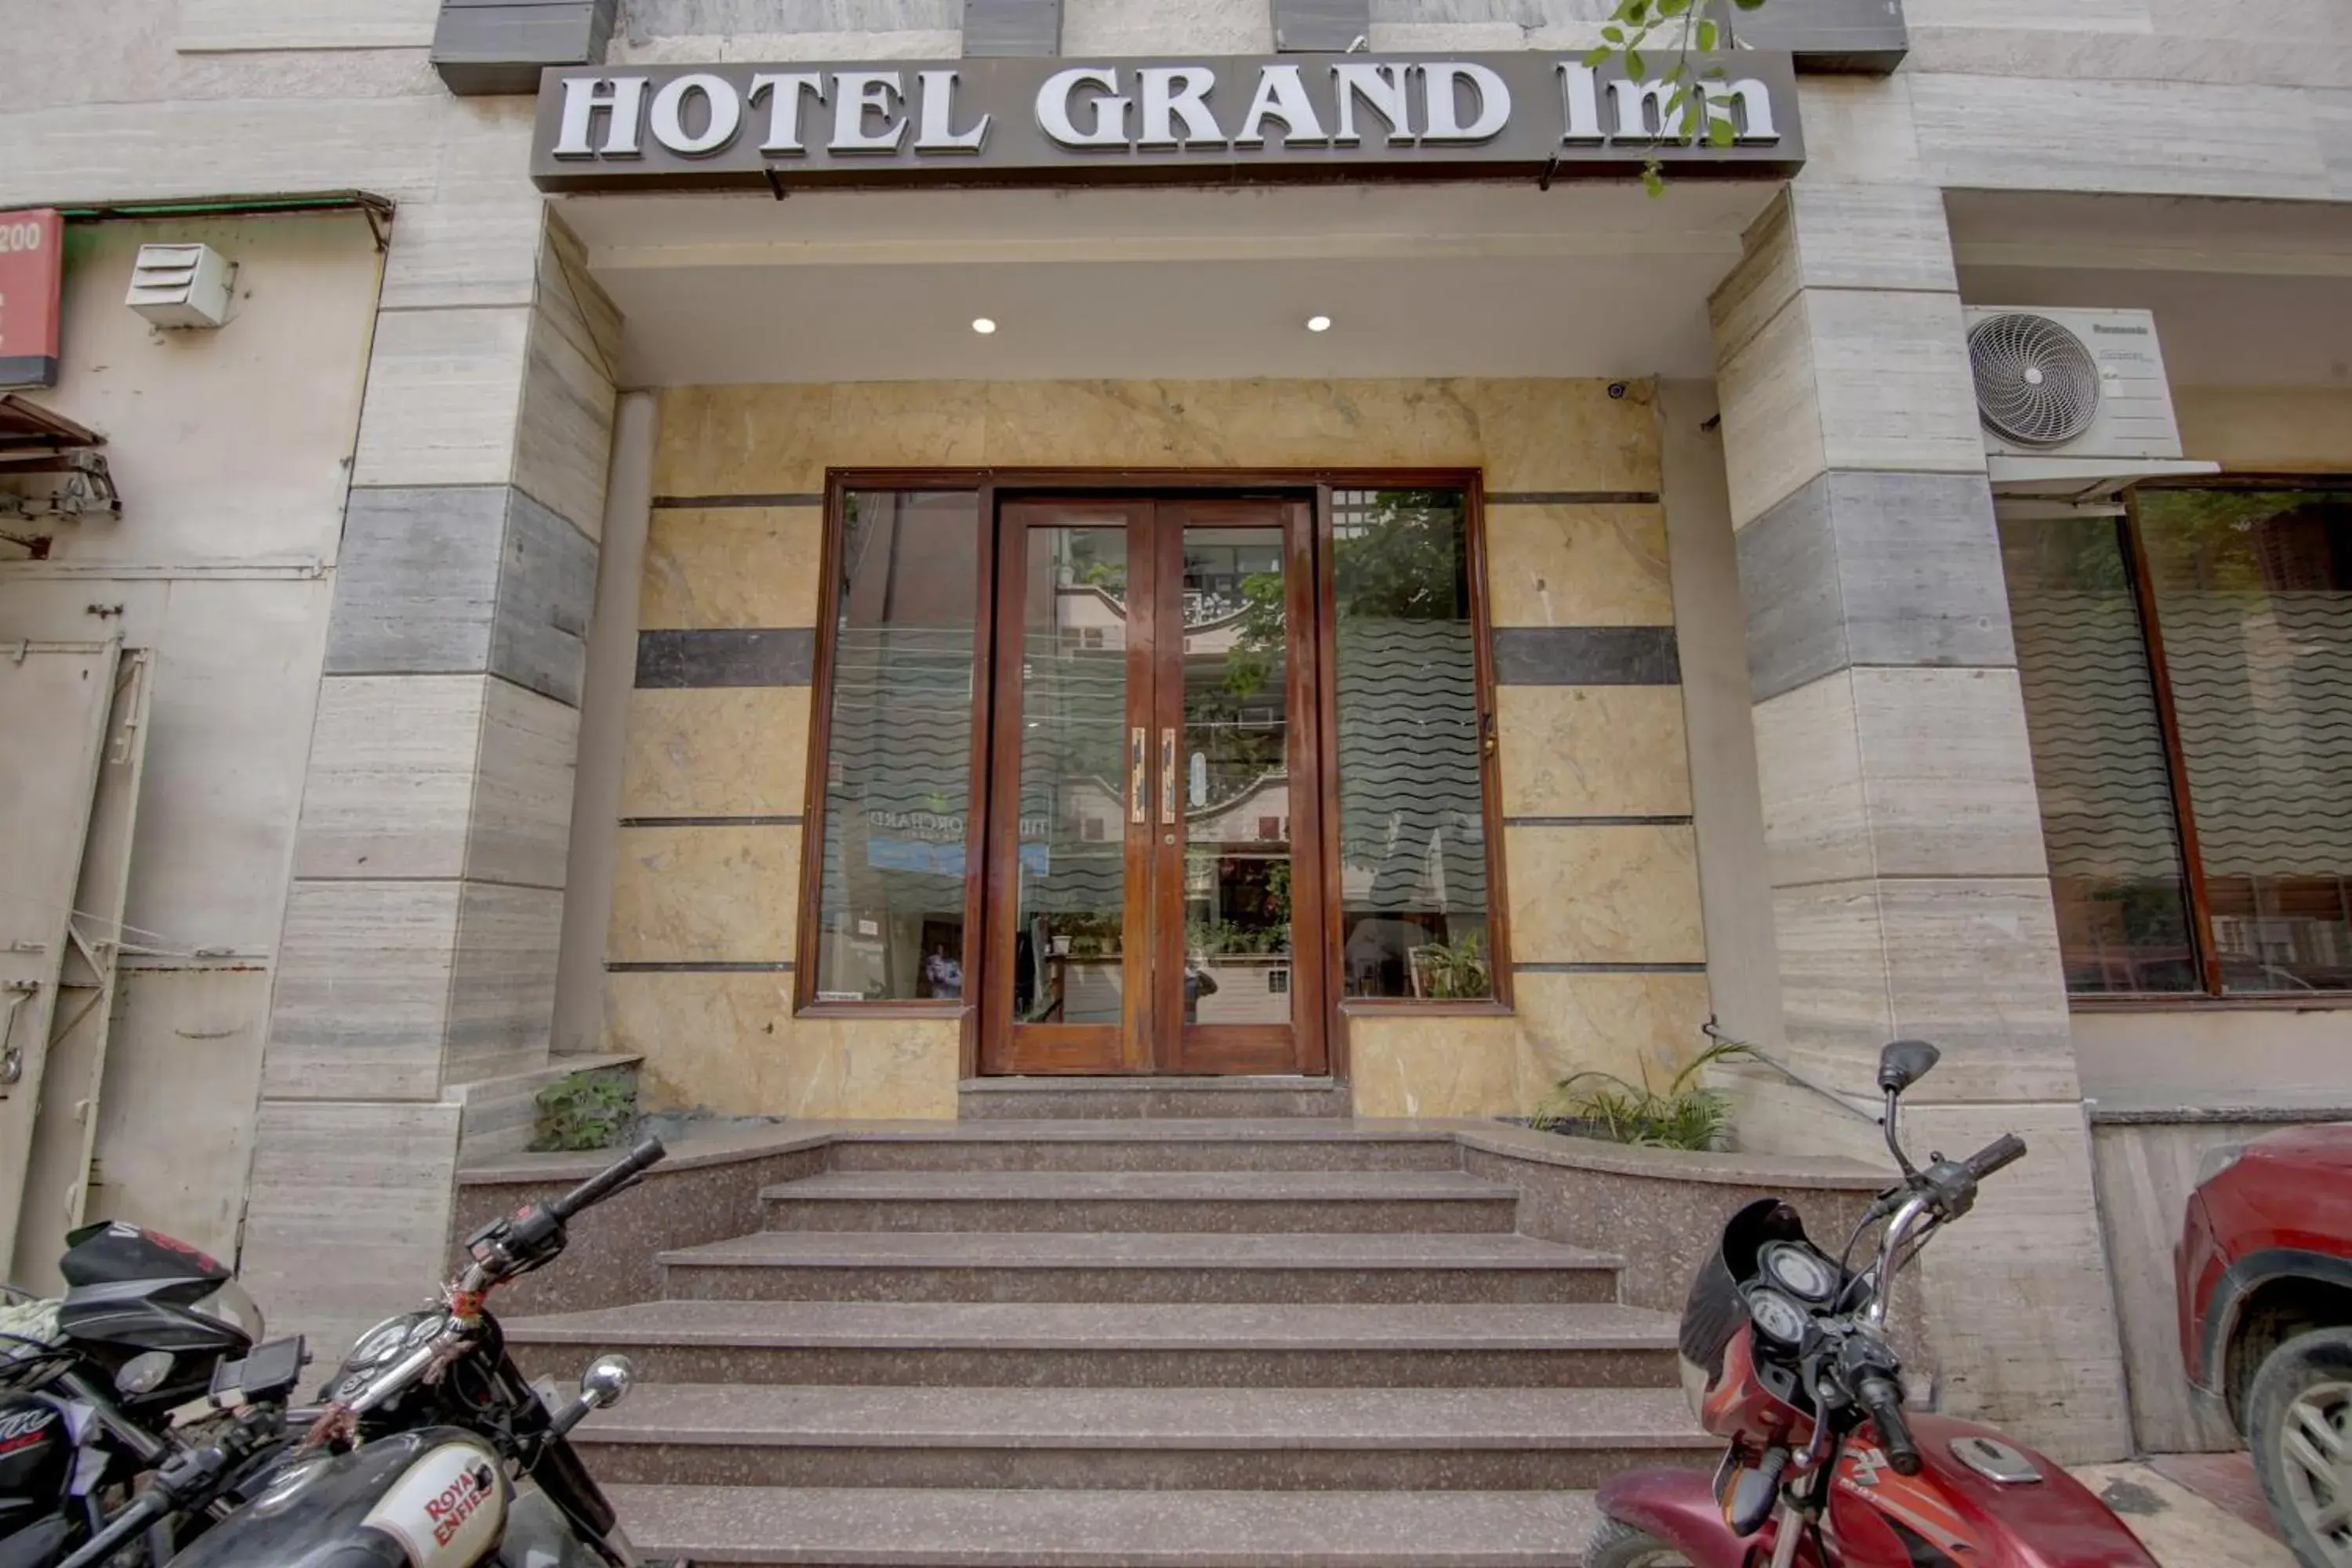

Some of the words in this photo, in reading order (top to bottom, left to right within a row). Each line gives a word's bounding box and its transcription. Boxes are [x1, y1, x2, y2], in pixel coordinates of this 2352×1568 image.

[552, 70, 992, 158] HOTEL
[1035, 64, 1512, 149] GRAND
[1555, 60, 1781, 147] Inn
[434, 1486, 493, 1548] ENFIE
